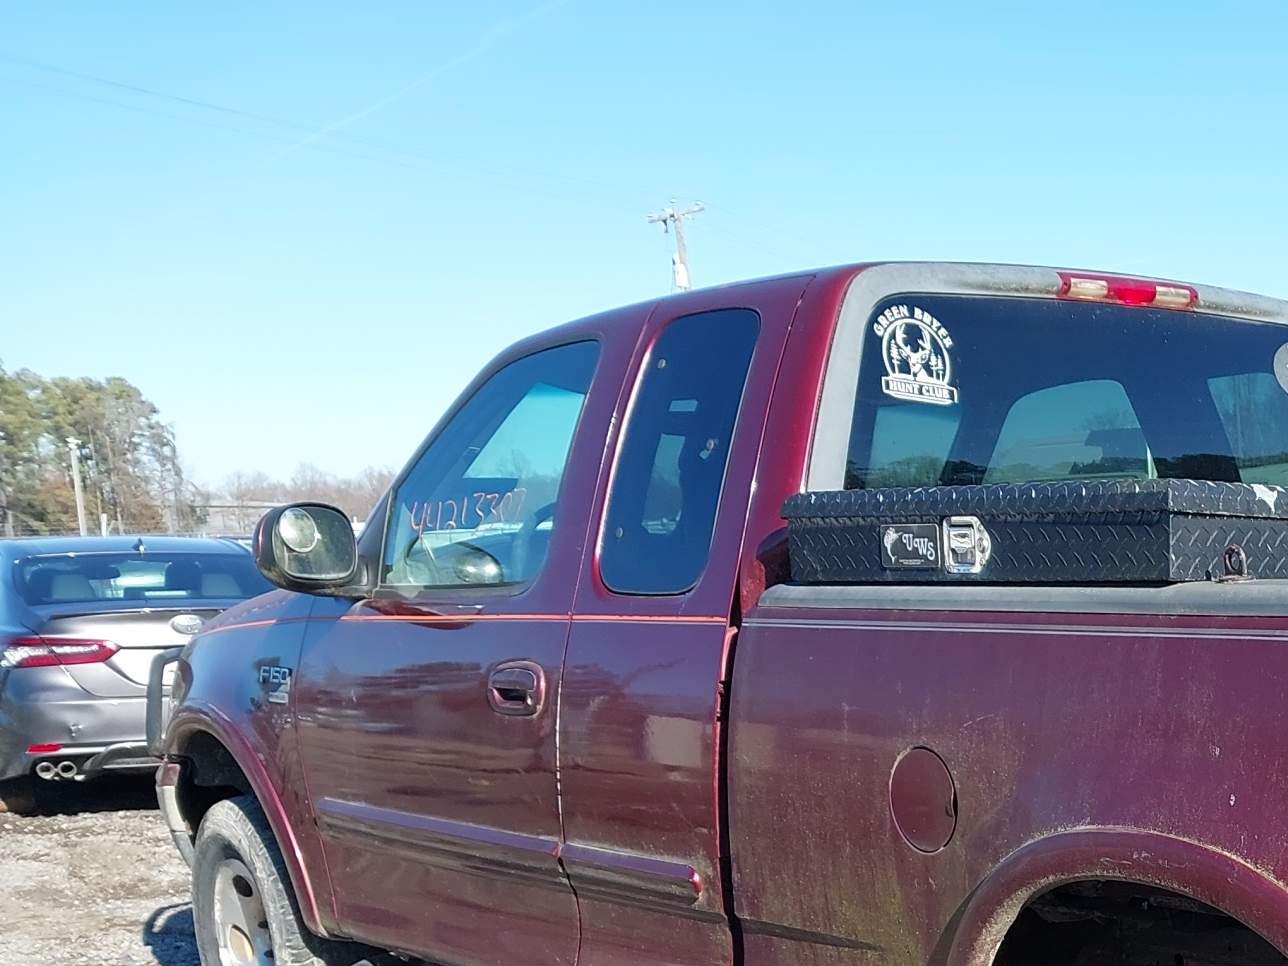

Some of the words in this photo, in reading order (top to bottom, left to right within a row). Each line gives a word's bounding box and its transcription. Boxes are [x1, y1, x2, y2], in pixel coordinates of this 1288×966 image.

[873, 304, 910, 337] GREEN
[888, 380, 919, 394] HUNT
[921, 385, 951, 399] CLUB
[902, 533, 936, 561] UWS
